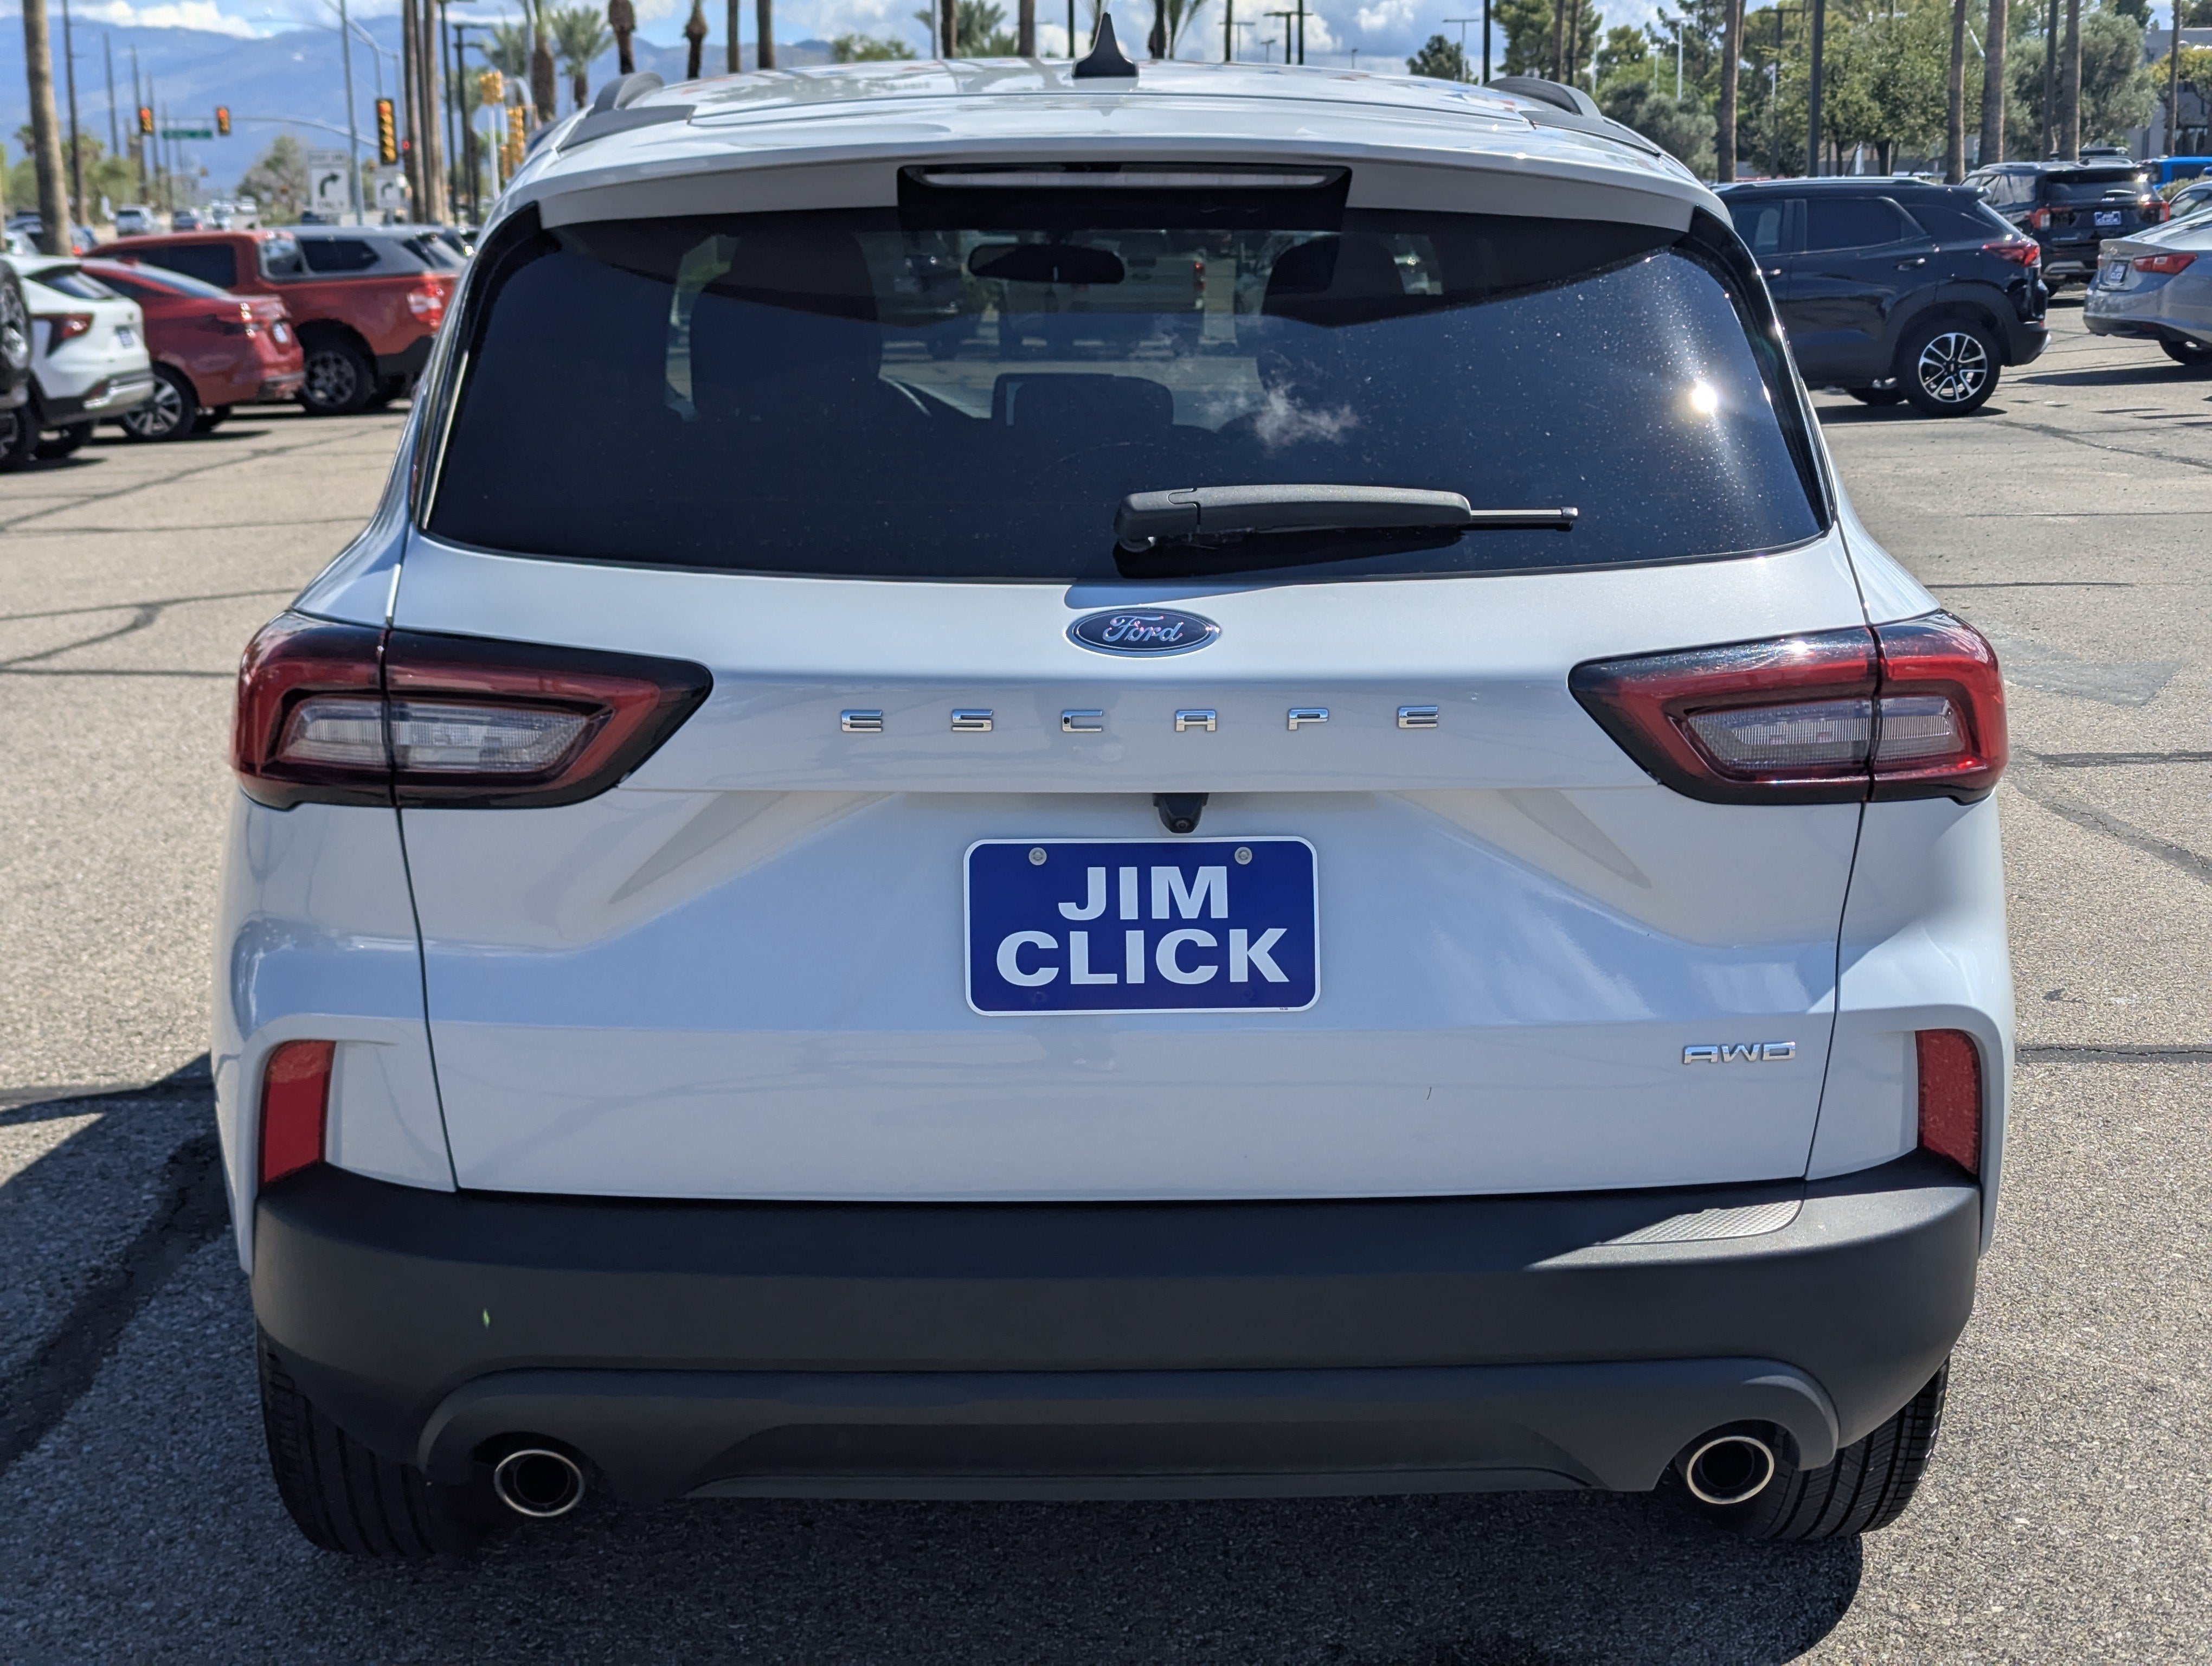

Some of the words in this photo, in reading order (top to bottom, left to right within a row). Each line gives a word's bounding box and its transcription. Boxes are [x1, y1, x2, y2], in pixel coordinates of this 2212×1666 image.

[1102, 616, 1184, 642] Ford
[841, 706, 1439, 733] ESCAPE
[1057, 866, 1229, 921] JIM
[996, 928, 1290, 986] CLICK
[1682, 1041, 1796, 1064] AWD
